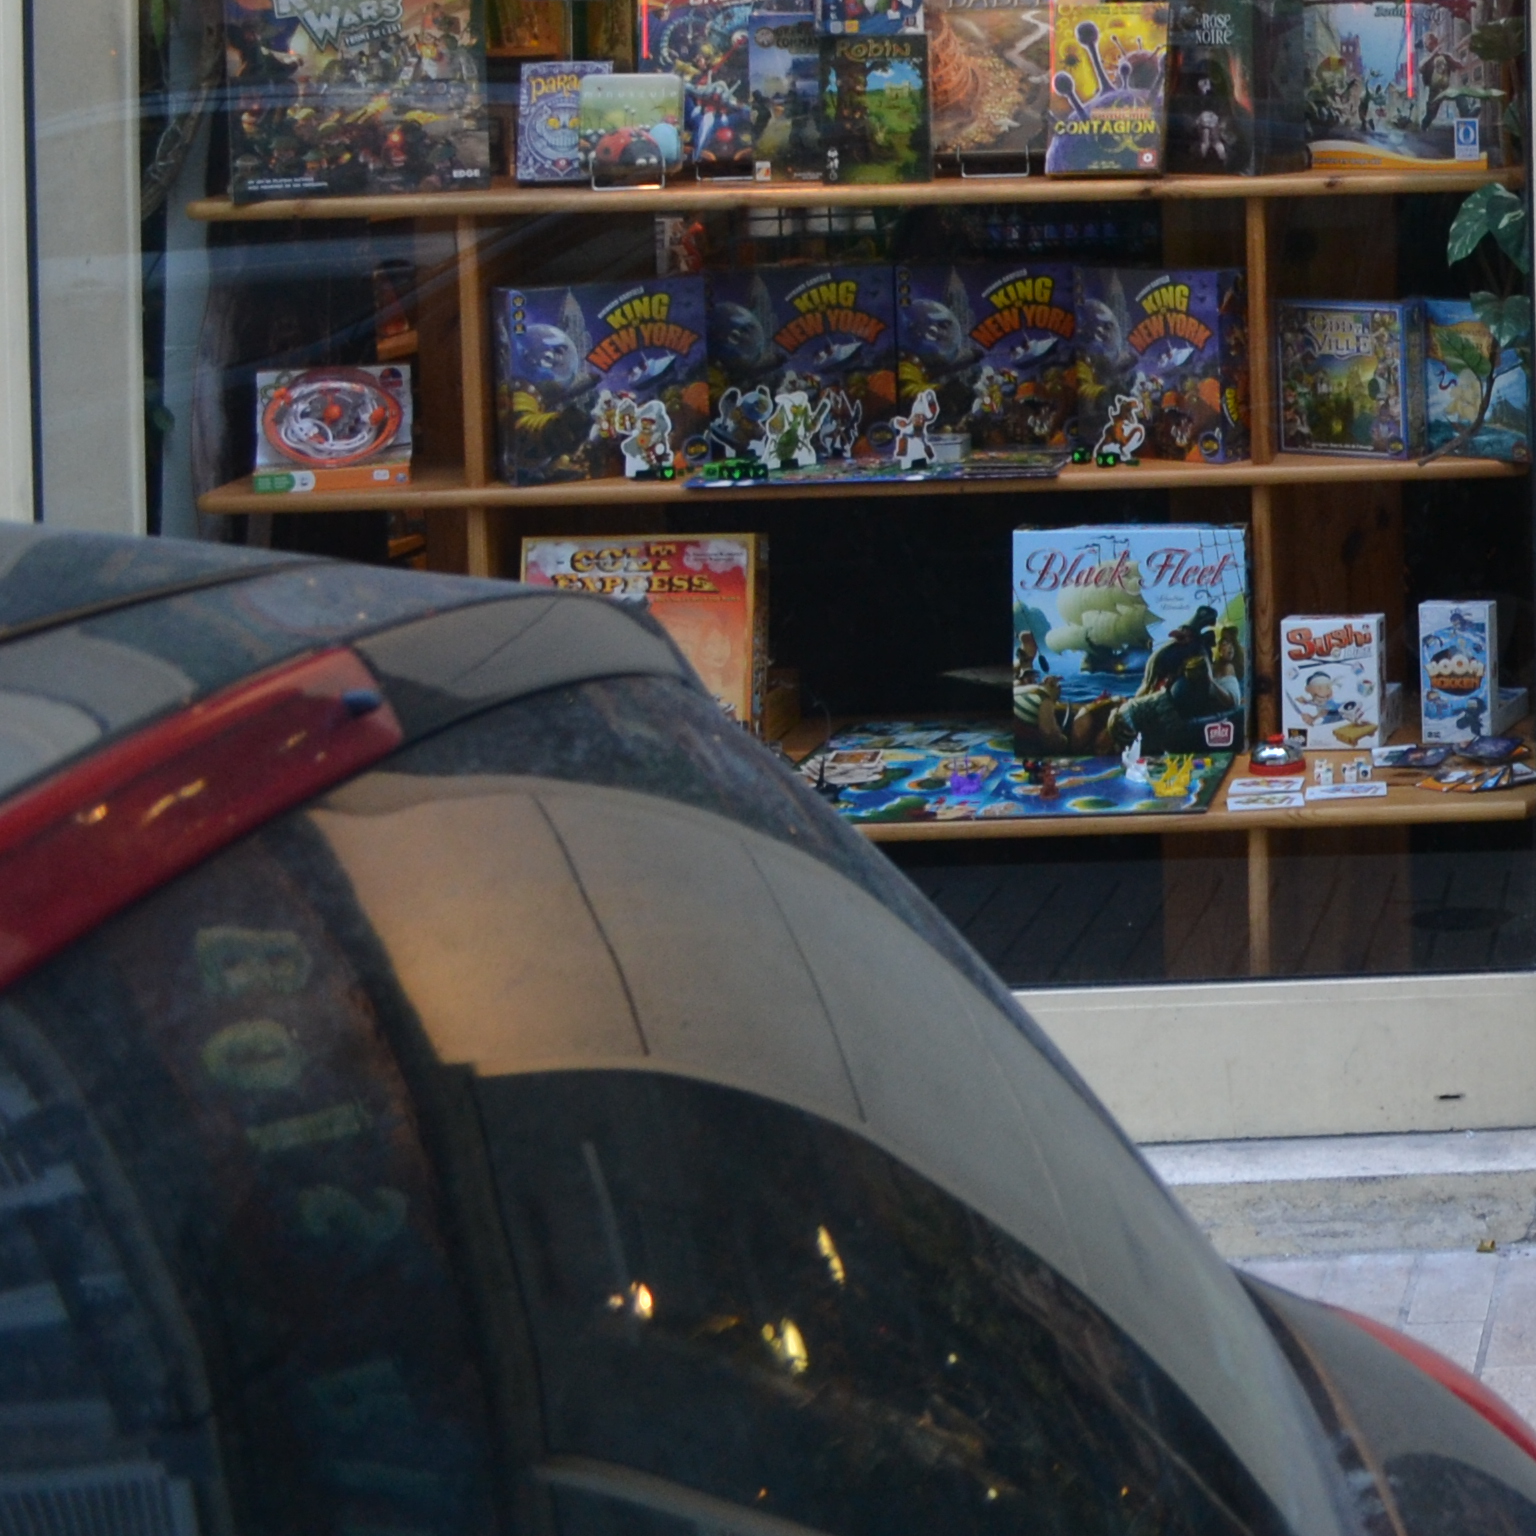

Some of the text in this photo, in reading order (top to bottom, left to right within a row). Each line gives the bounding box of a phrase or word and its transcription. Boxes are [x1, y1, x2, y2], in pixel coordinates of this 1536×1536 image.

[1055, 120, 1157, 135] CONTAGION
[453, 168, 480, 178] EDGE
[793, 280, 857, 313] KING
[989, 275, 1054, 310] KING
[1141, 283, 1190, 314] KING
[606, 293, 670, 329] KING
[968, 304, 1075, 351] NEW YORK
[586, 321, 701, 374] NEW YORK
[773, 308, 887, 355] NEW YORK
[1127, 312, 1213, 355] NEW YORK
[570, 544, 676, 572] COLT
[1020, 547, 1238, 591] Black Fleet
[552, 574, 720, 594] EXPRESS
[1286, 624, 1373, 661] Sushi
